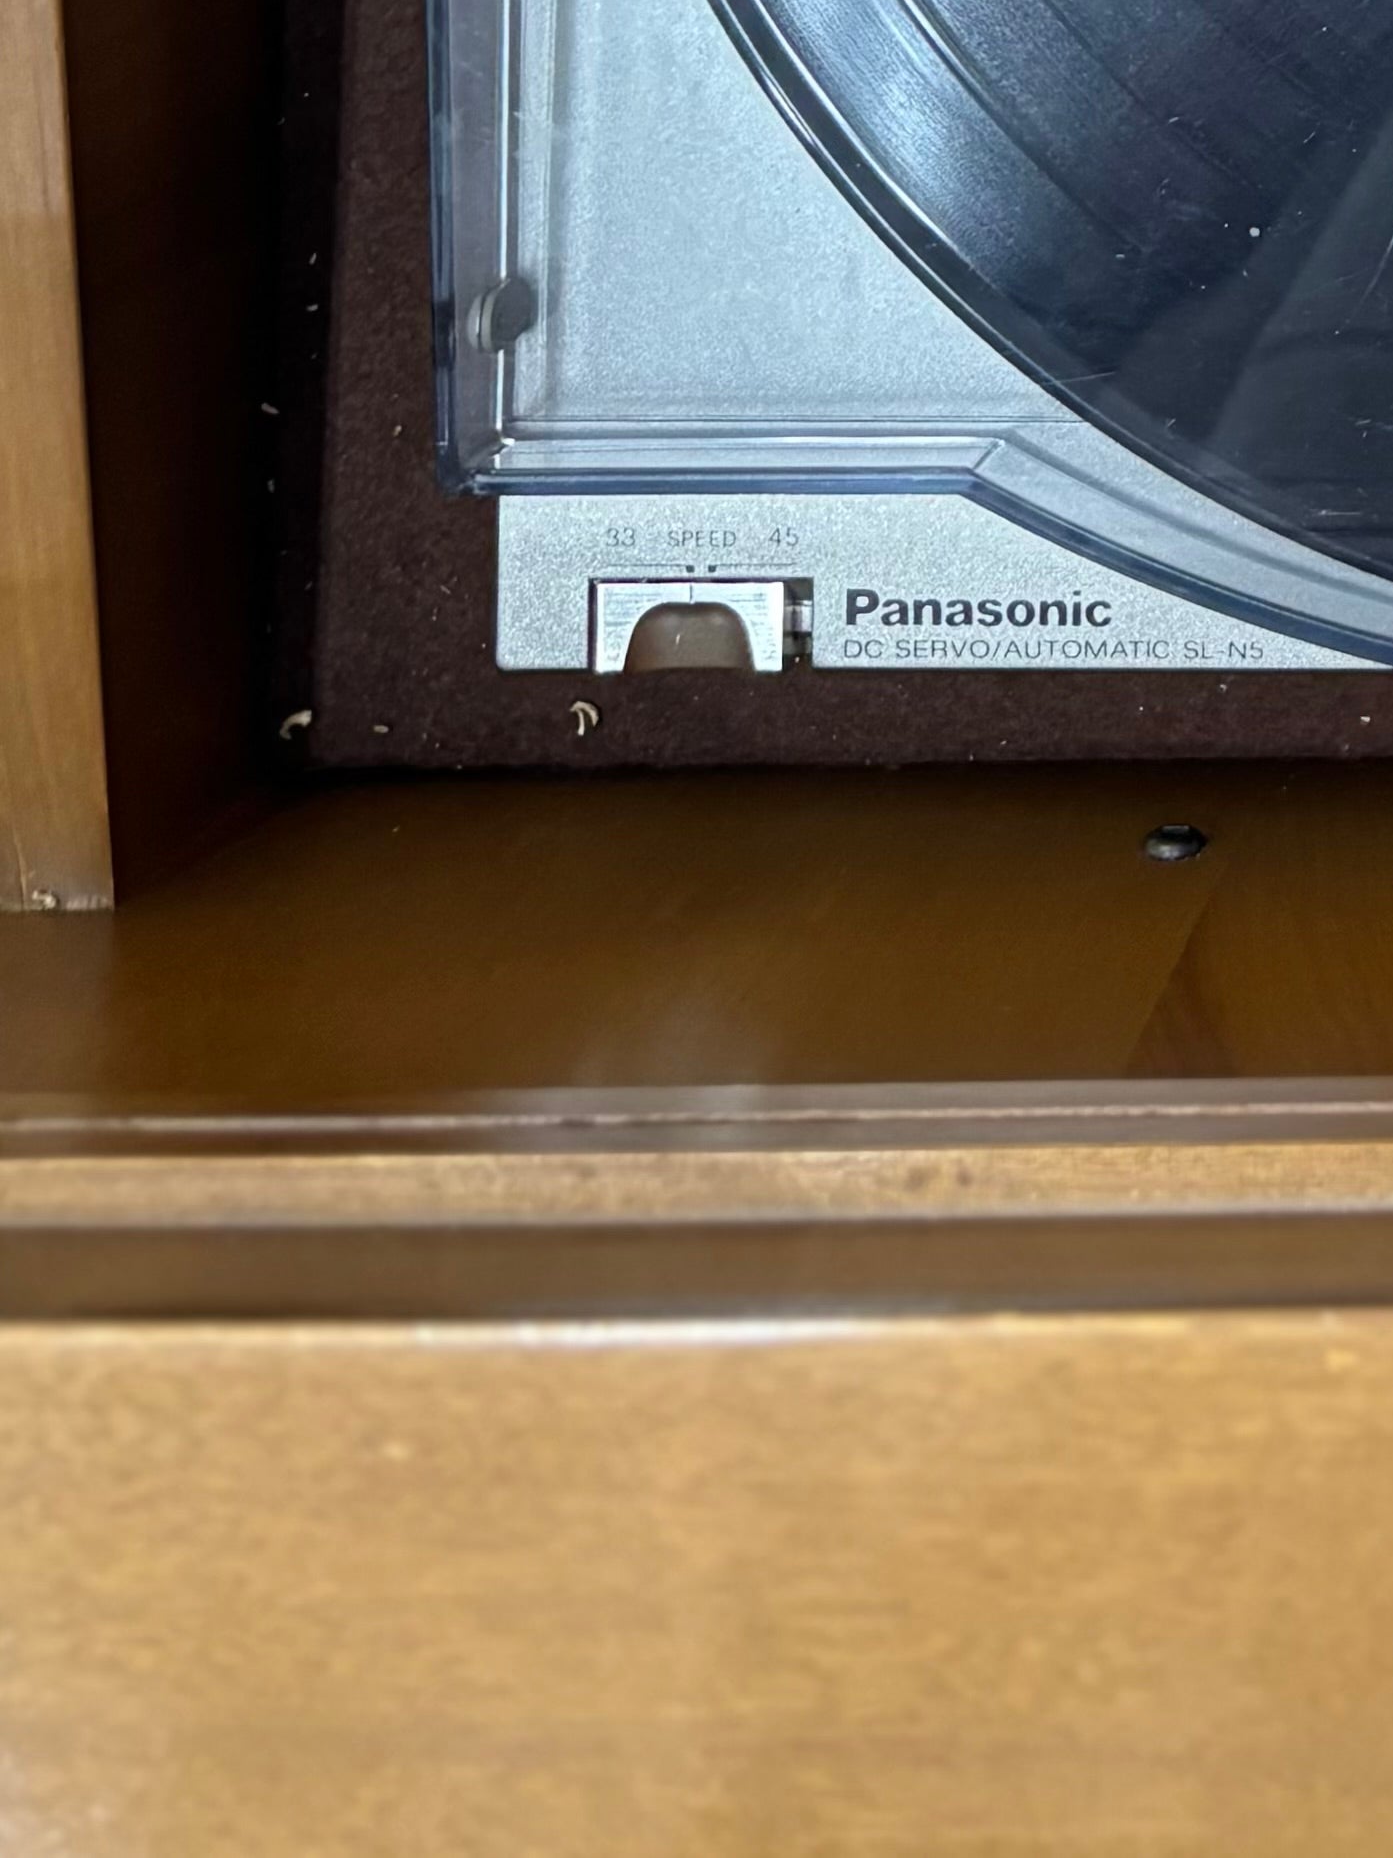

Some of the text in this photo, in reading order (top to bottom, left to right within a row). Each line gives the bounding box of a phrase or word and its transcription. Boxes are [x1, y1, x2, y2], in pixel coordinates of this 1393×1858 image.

[606, 527, 799, 548] 33 SPEED 45
[845, 588, 1112, 626] Panasonic
[843, 638, 1265, 660] DC SERVO/AUTOMATIC SL-N5
